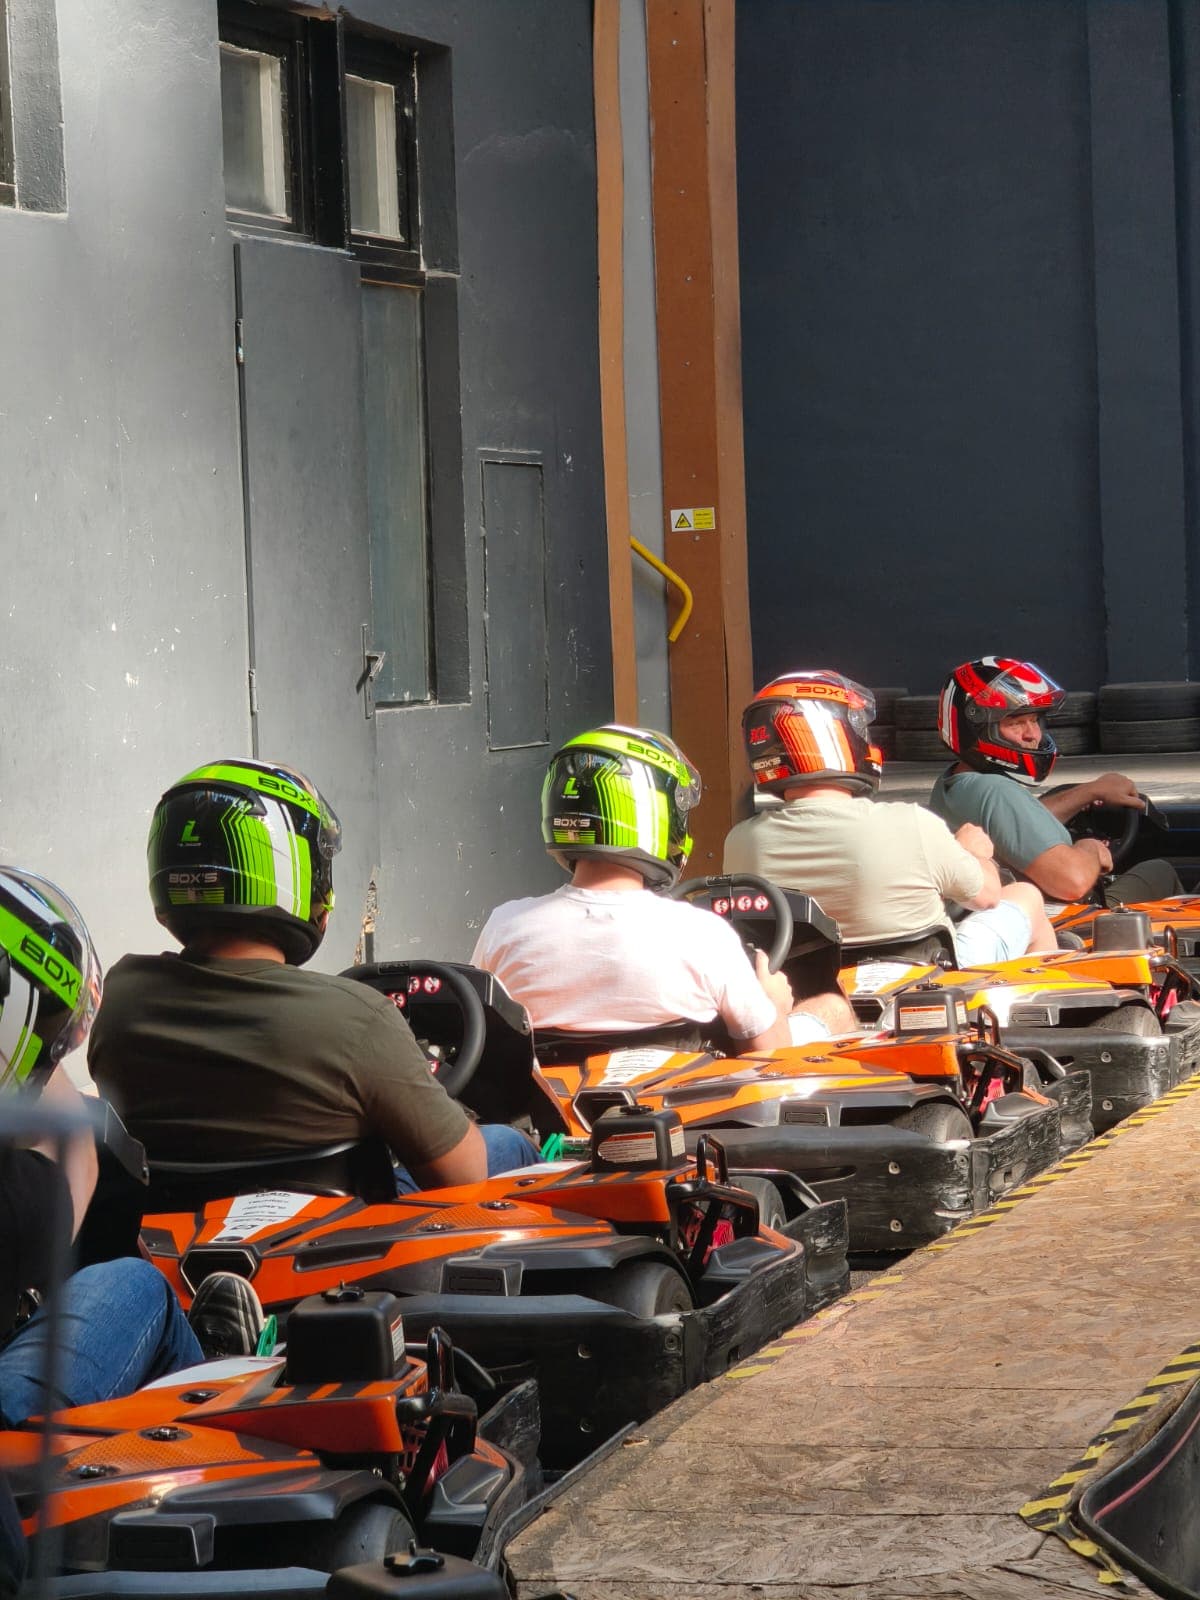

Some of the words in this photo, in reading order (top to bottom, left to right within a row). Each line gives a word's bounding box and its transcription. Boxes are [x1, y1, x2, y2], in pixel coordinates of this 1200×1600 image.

[563, 777, 578, 795] L
[553, 817, 590, 828] BOX'S
[181, 820, 200, 842] L
[168, 872, 218, 884] BOX'S
